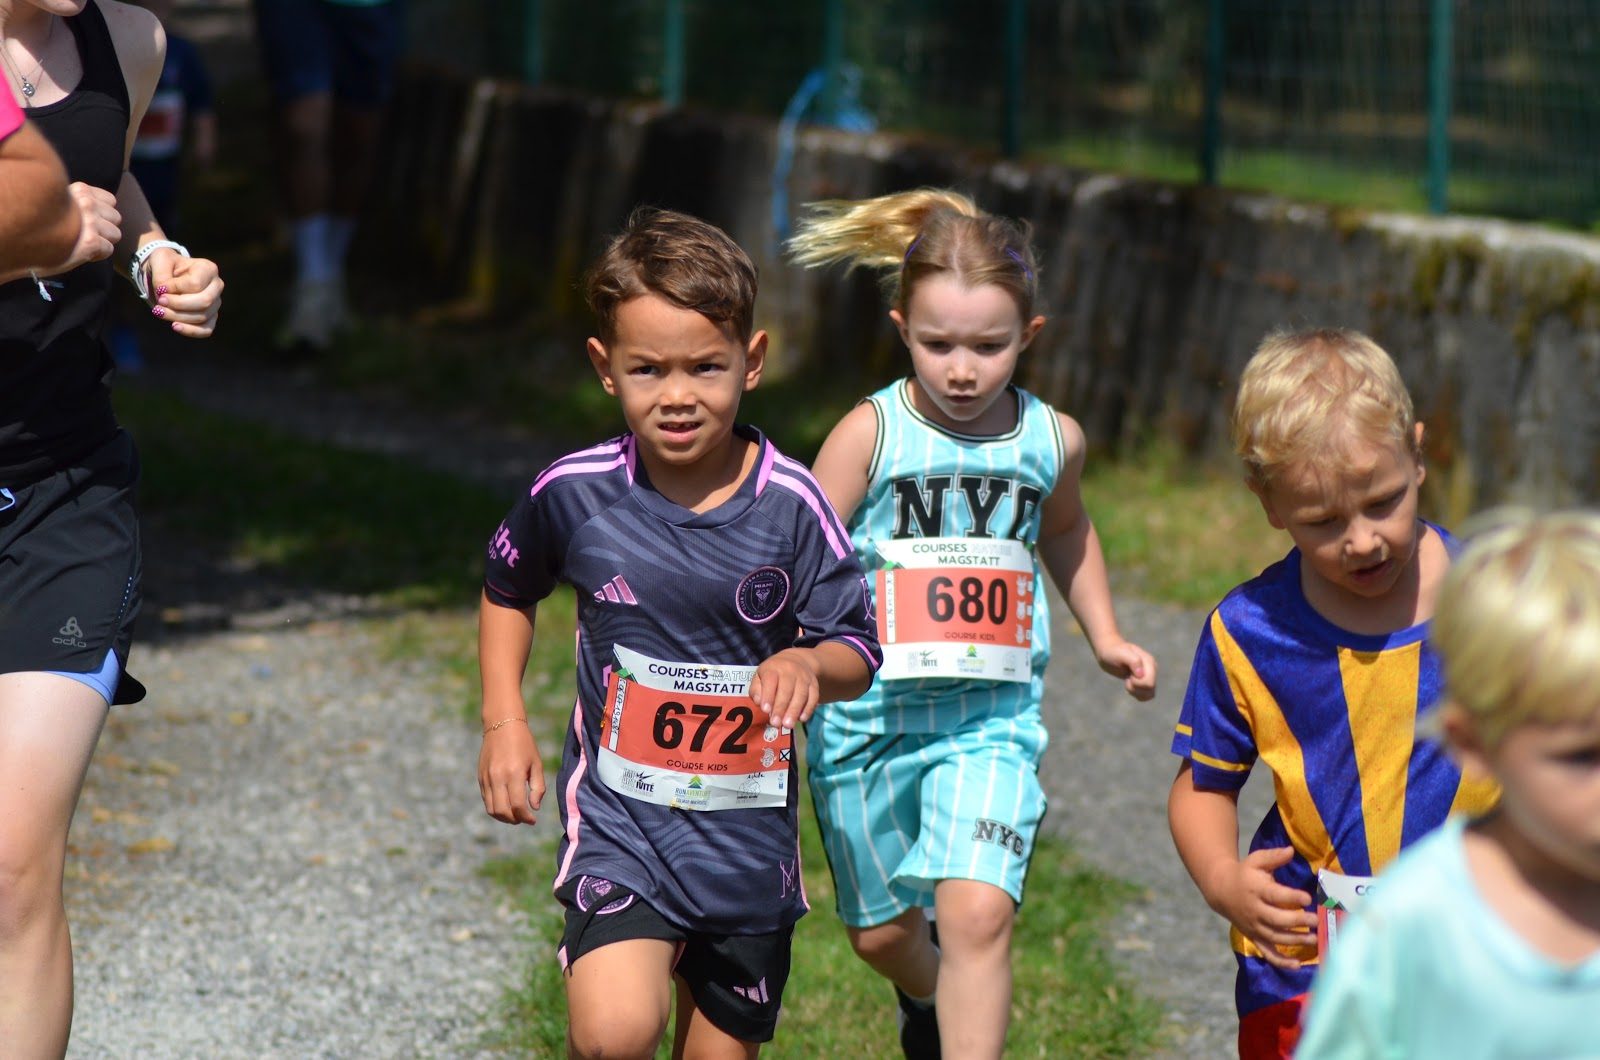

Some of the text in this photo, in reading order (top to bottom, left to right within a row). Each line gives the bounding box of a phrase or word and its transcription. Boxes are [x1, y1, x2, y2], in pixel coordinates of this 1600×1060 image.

[912, 543, 968, 554] COURSES
[938, 555, 1000, 566] MAGSTATT
[926, 576, 1008, 626] 680
[52, 636, 87, 648] odlo
[944, 631, 996, 642] COURSE KIDS
[648, 663, 758, 682] COURSES NATUR
[673, 680, 745, 694] MAGSTATT
[652, 701, 754, 755] 672
[666, 759, 728, 772] COURSE KIDS
[972, 818, 1024, 860] NYC
